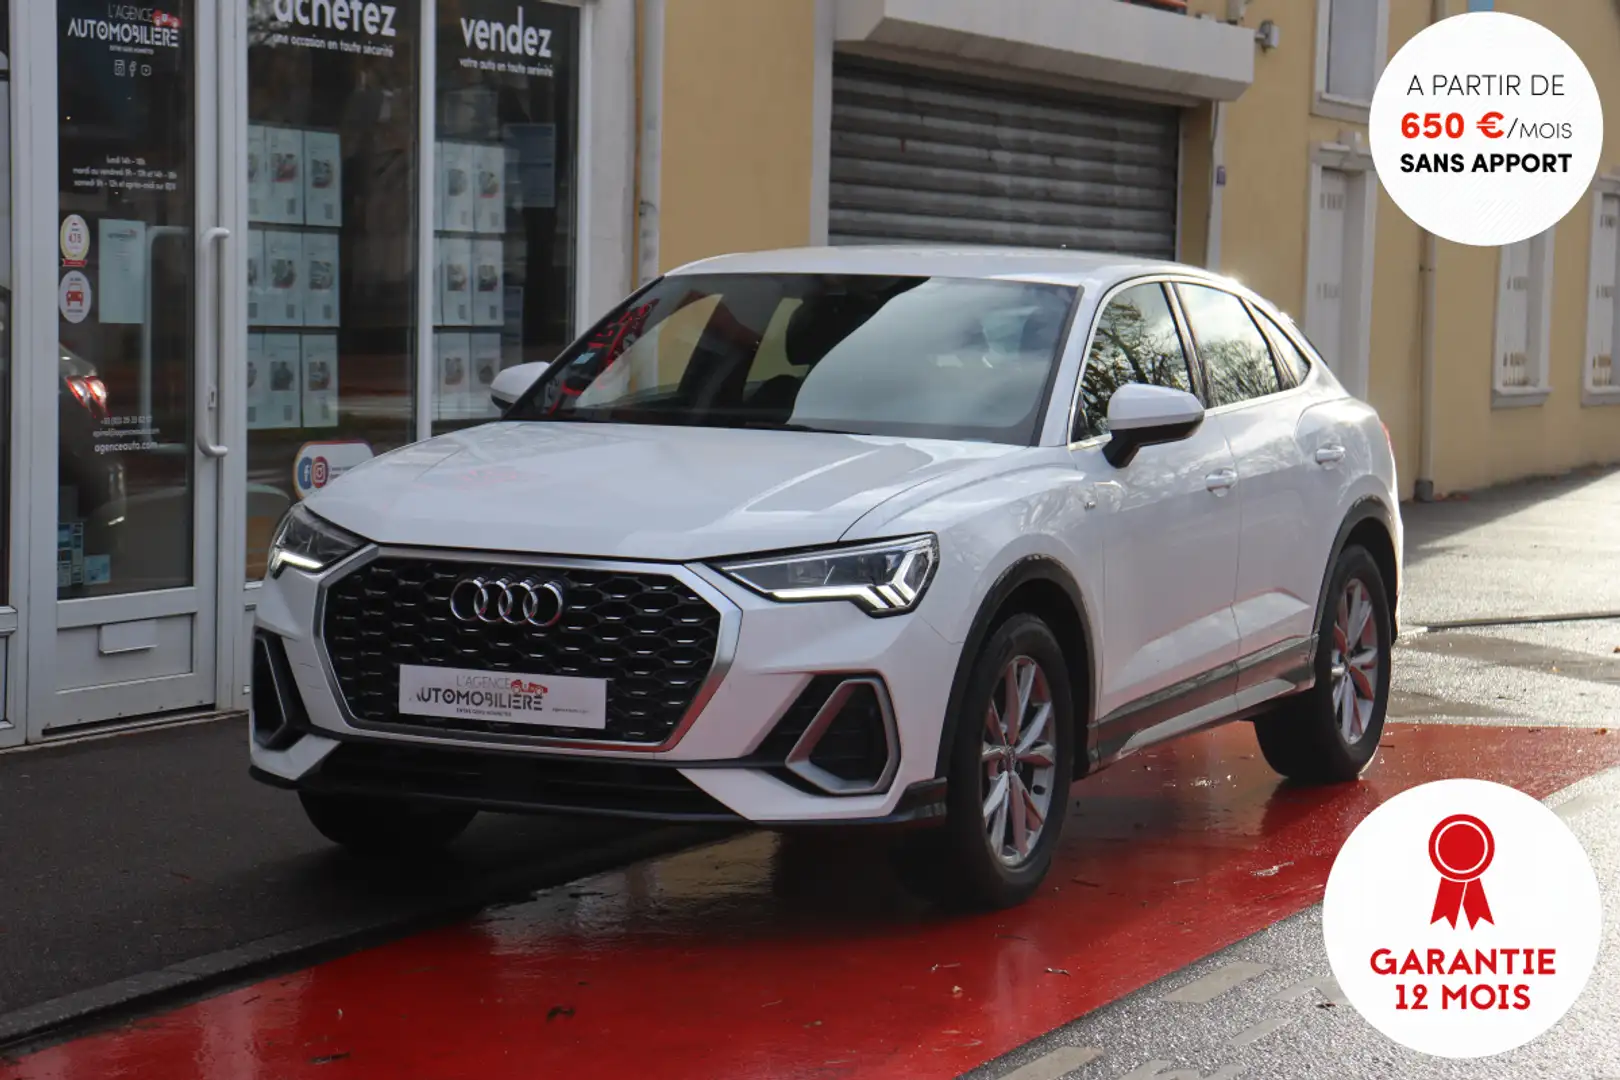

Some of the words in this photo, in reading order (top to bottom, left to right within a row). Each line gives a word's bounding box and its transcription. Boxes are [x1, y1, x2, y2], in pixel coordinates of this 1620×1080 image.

[273, 0, 397, 37] achetez
[460, 5, 552, 58] vendez
[291, 33, 326, 49] occasion
[327, 39, 338, 50] en
[340, 39, 362, 53] toute
[456, 675, 511, 690] L'AGENCE
